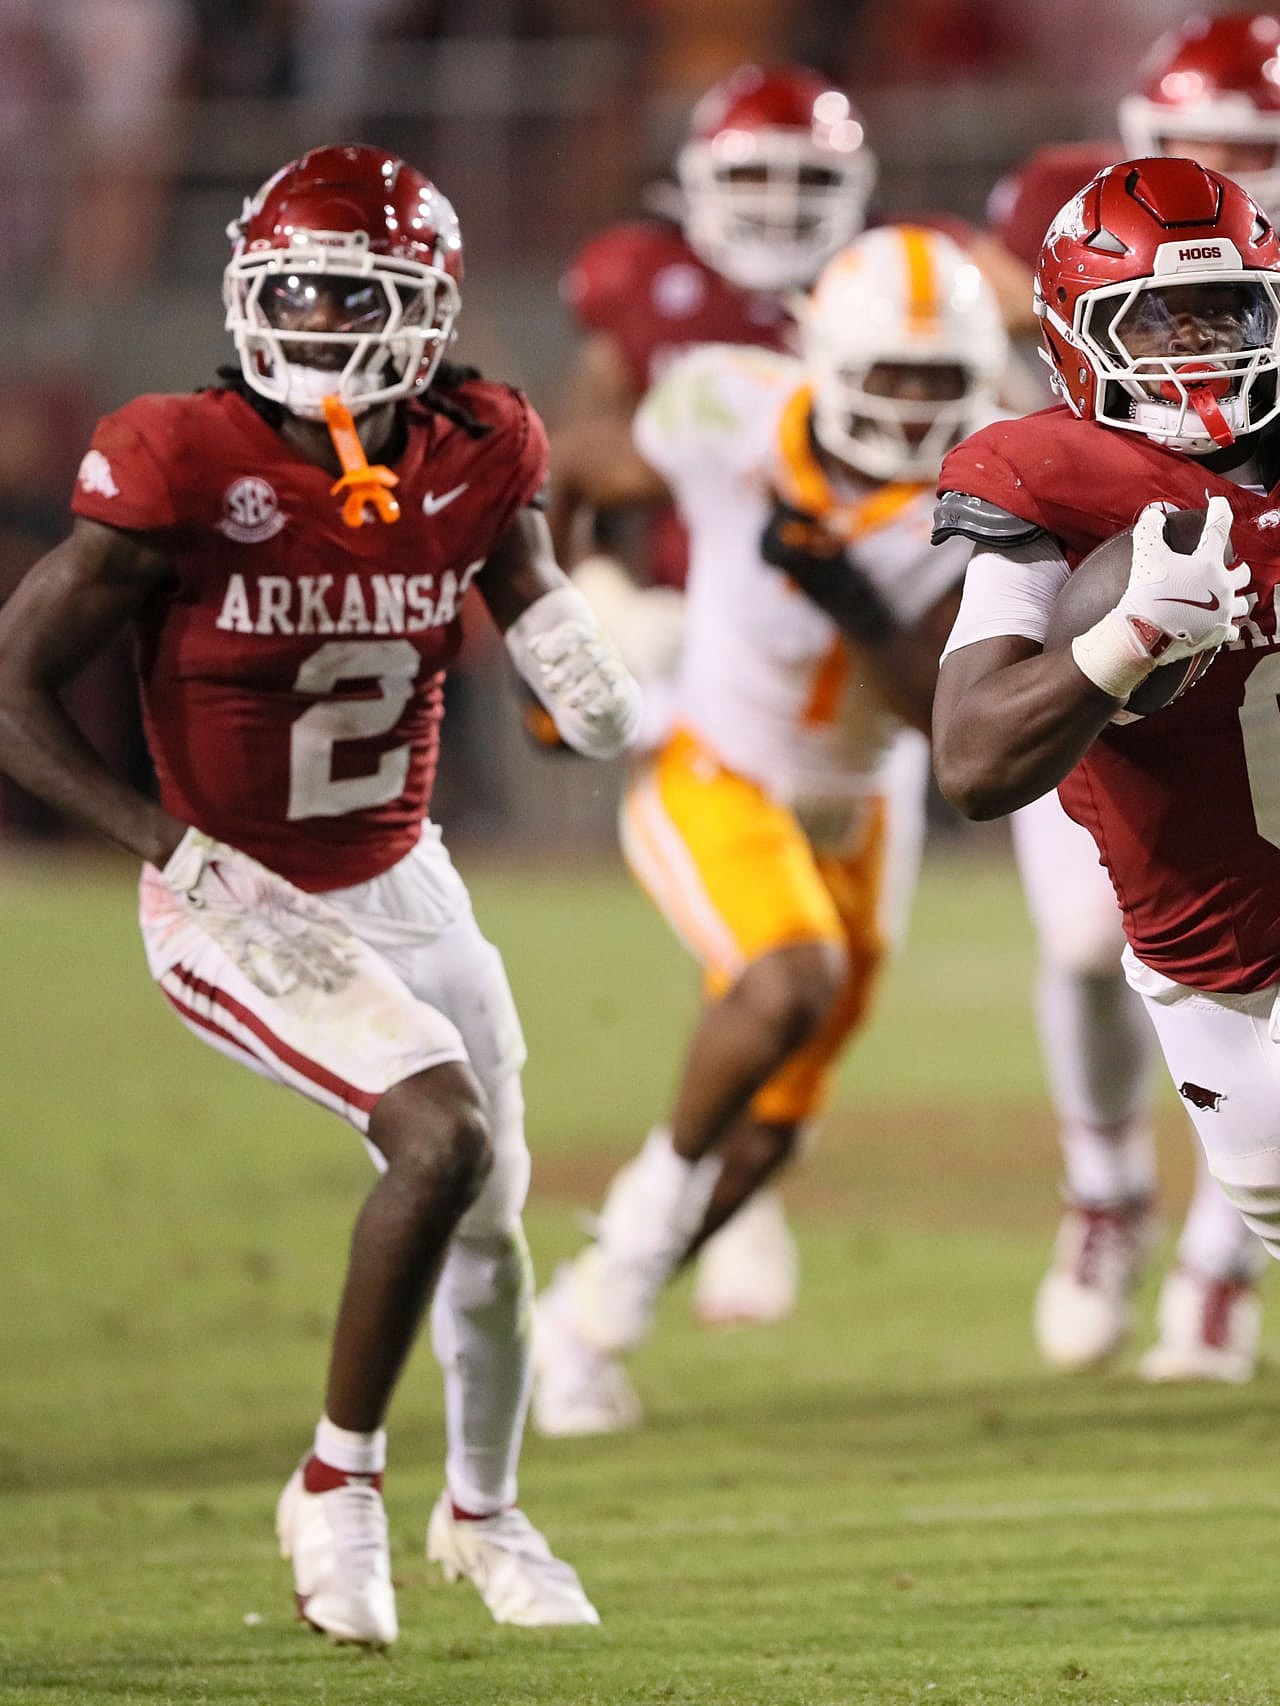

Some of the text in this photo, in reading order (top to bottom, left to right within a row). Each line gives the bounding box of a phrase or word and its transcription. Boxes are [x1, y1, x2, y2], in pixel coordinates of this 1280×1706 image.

[1179, 247, 1222, 260] HOGS
[229, 480, 275, 525] SEC
[287, 638, 421, 820] 2
